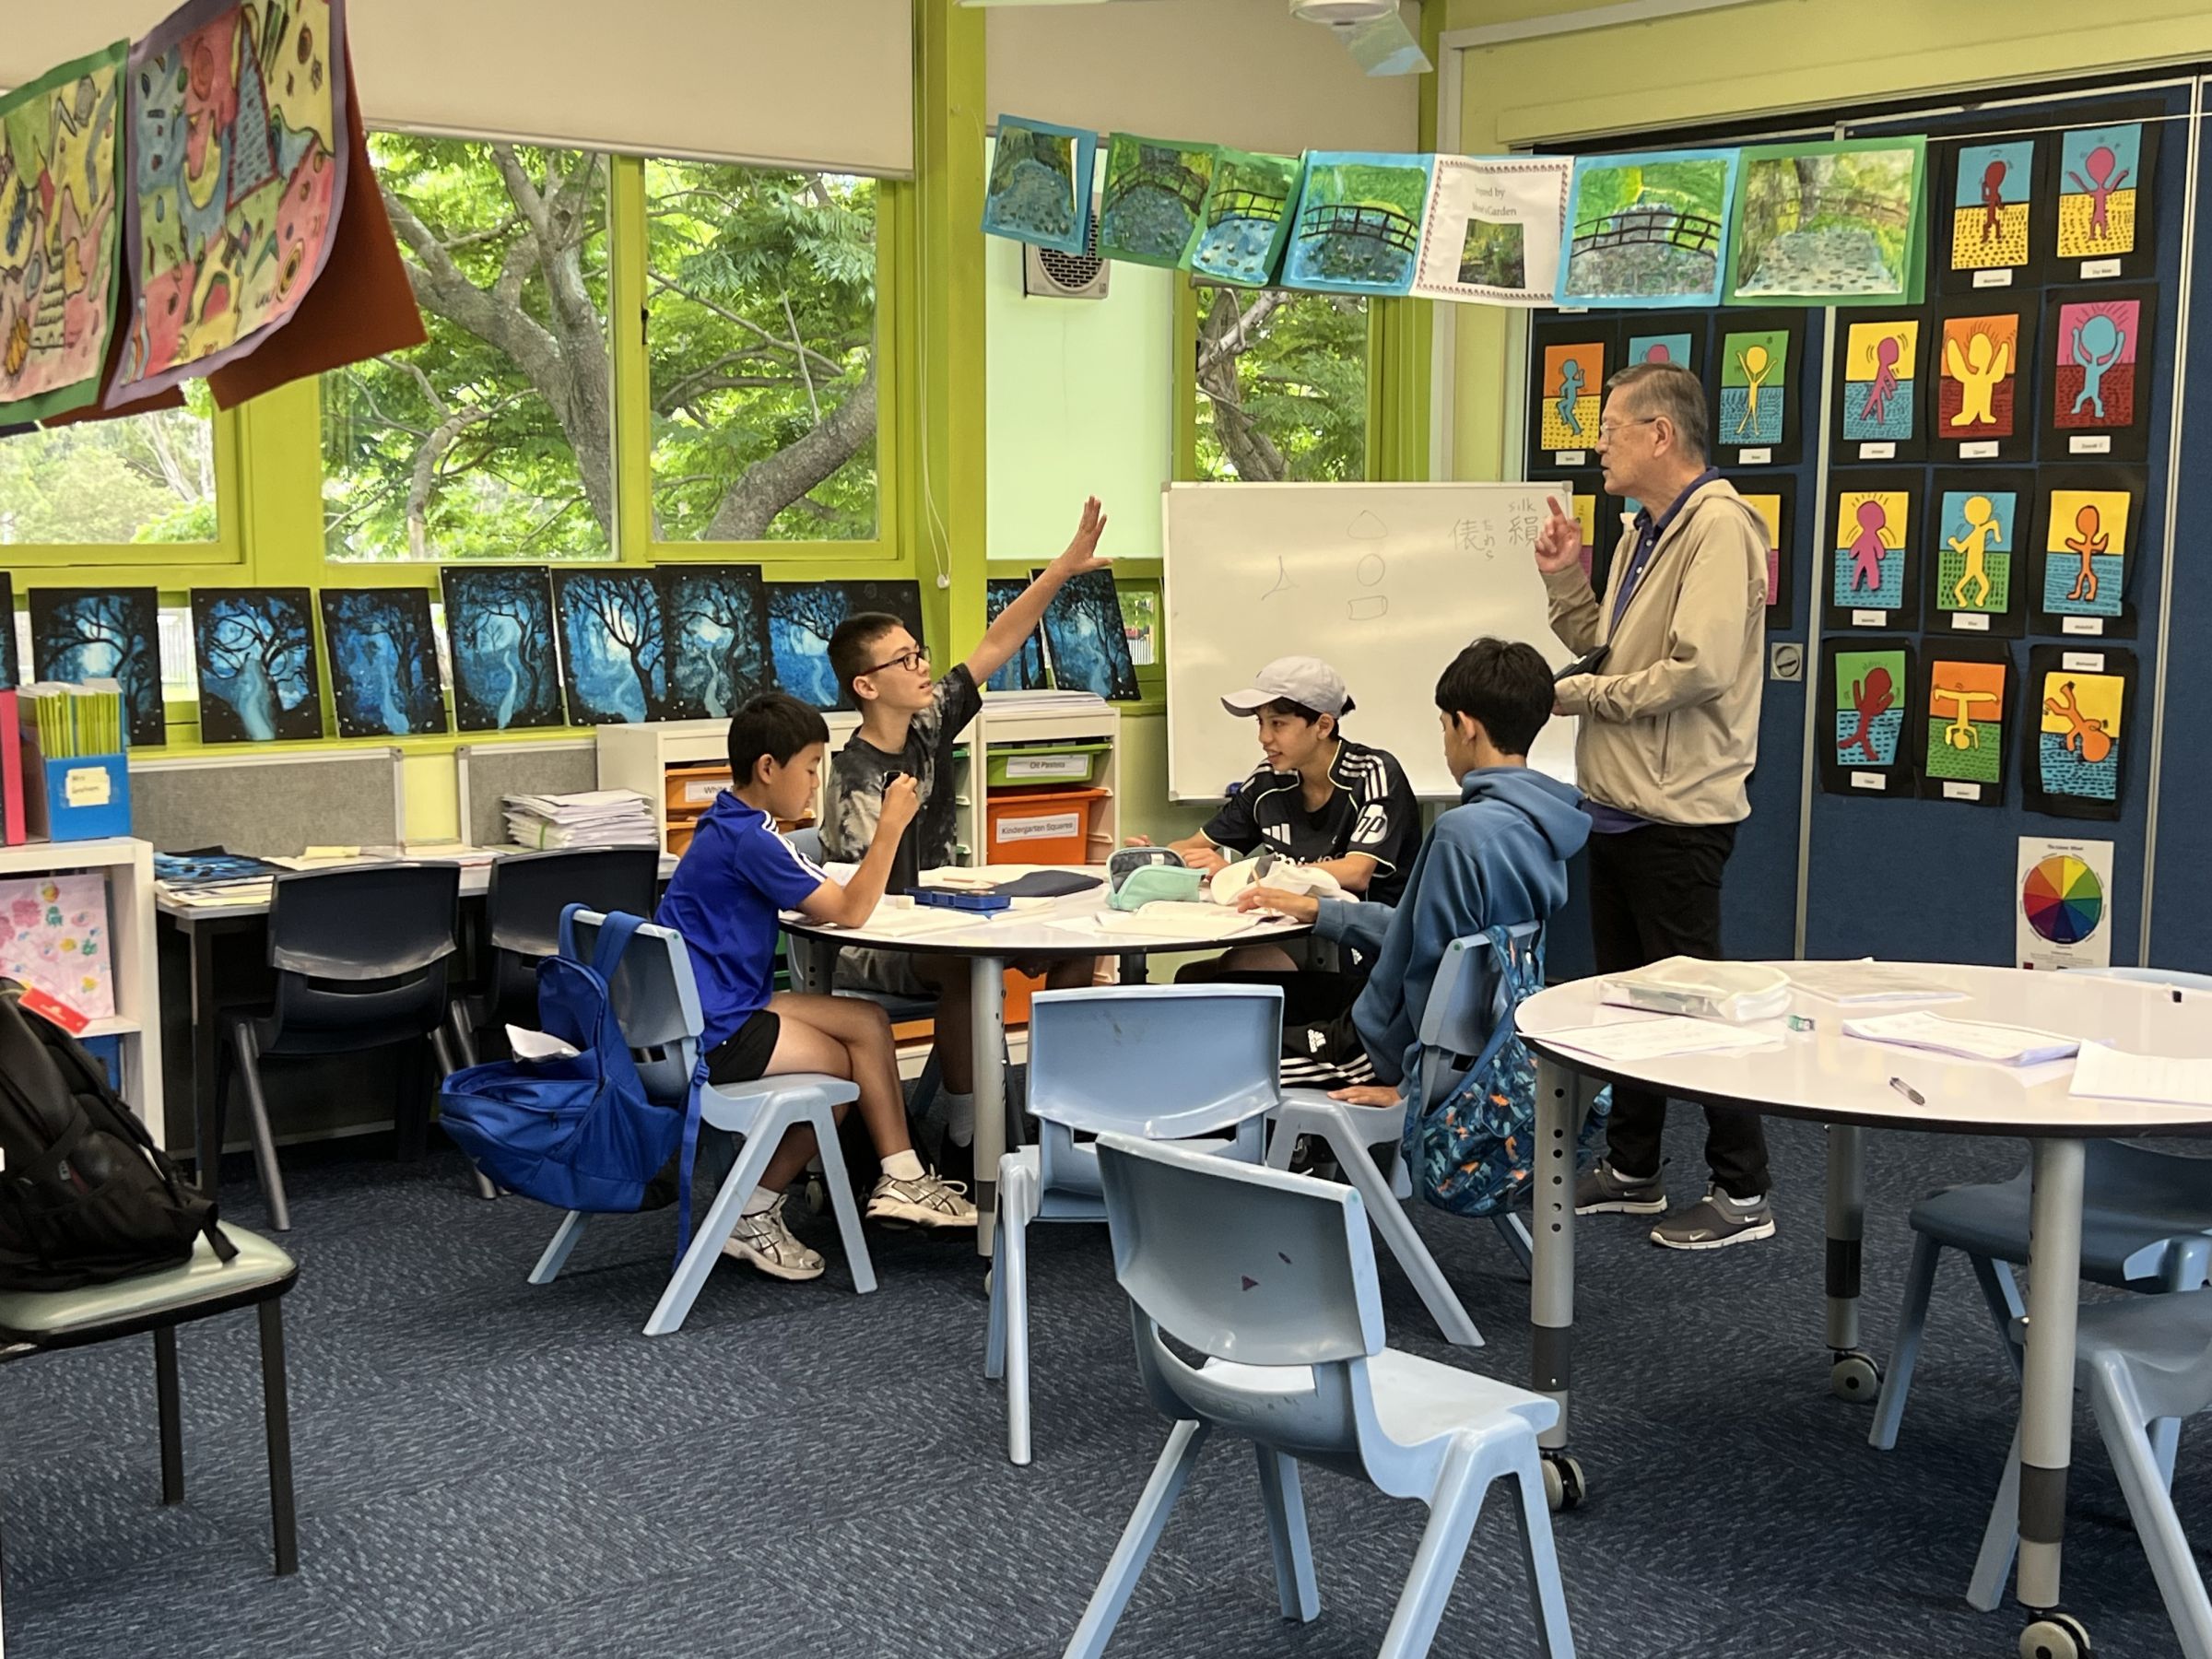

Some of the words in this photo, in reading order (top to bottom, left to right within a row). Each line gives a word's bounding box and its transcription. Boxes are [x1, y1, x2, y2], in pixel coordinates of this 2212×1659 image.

[1509, 498, 1536, 512] silk
[1002, 825, 1045, 834] Kindergarten
[1047, 822, 1073, 830] Squares
